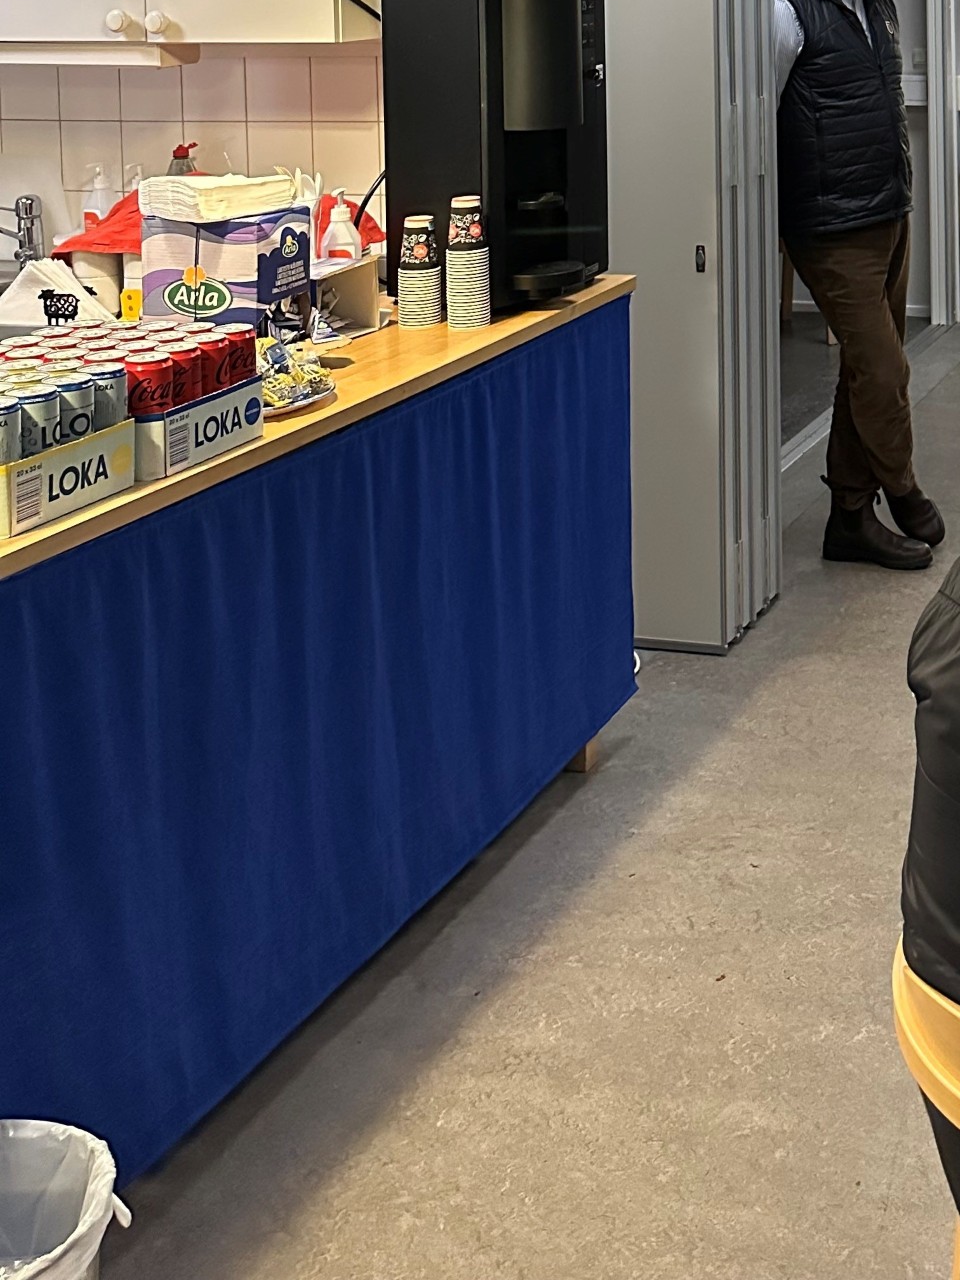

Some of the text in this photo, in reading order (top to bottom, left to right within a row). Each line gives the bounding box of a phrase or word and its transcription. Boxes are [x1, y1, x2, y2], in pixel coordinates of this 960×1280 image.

[173, 285, 219, 307] Arla
[94, 383, 115, 392] LOKA
[194, 406, 242, 449] LOKA
[48, 454, 109, 503] LOKA
